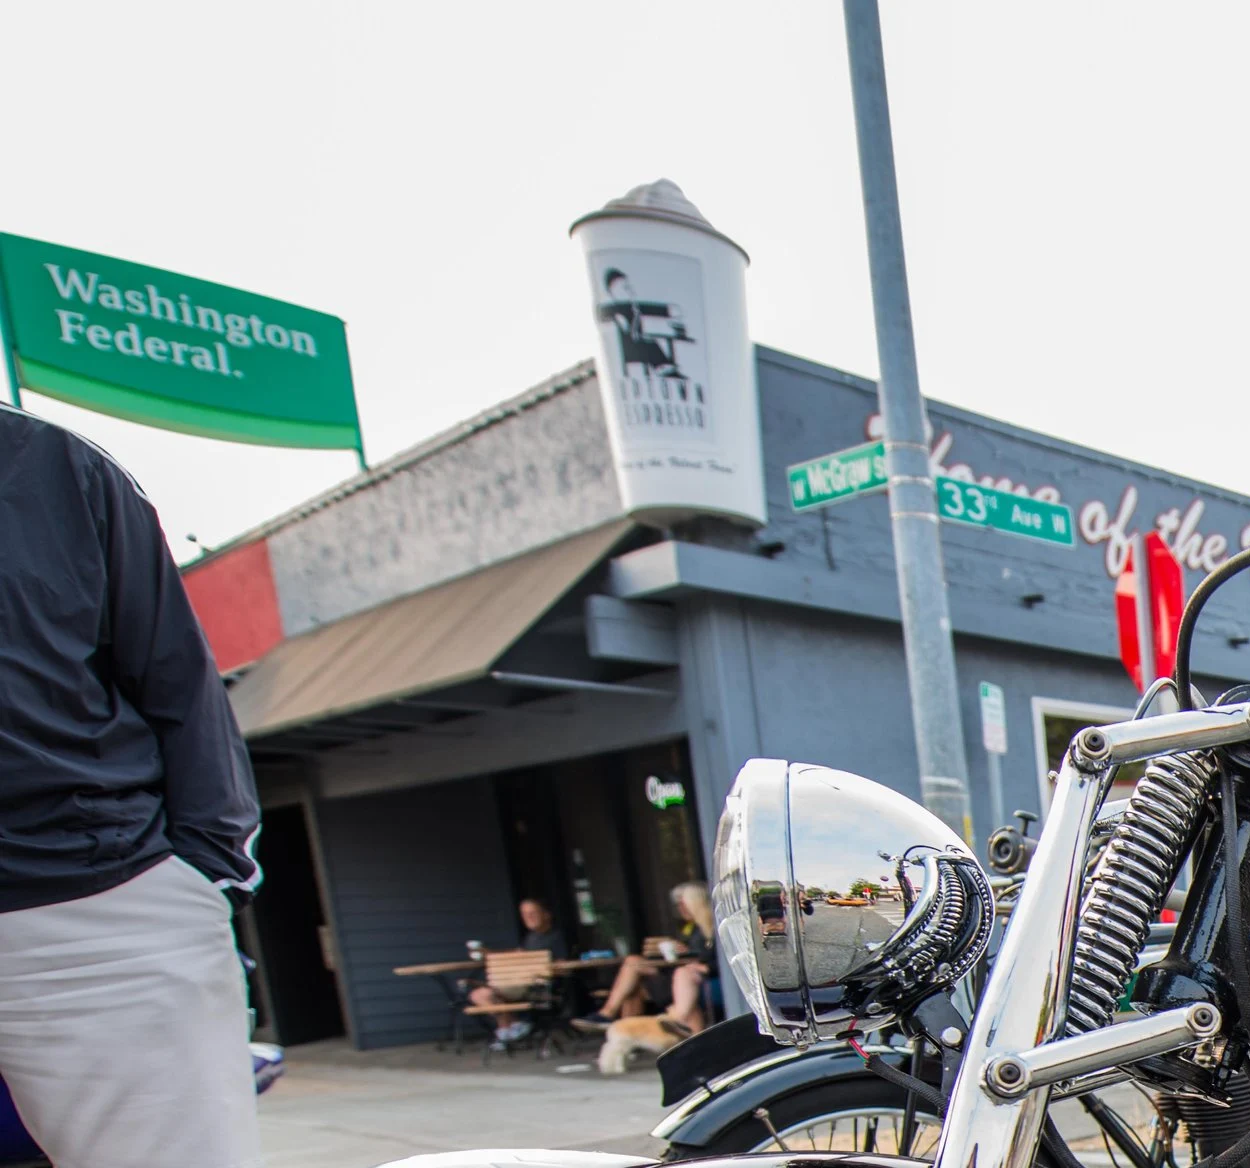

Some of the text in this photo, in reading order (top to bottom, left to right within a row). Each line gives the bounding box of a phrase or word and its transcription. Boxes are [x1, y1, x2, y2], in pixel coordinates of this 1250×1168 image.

[43, 262, 319, 359] Washington
[54, 307, 245, 380] Federal.
[806, 454, 871, 498] McGraw
[872, 455, 888, 480] S
[1011, 503, 1044, 531] Ave
[1052, 513, 1067, 535] W
[1080, 485, 1142, 579] of
[1157, 499, 1230, 574] the
[645, 775, 686, 809] Open
